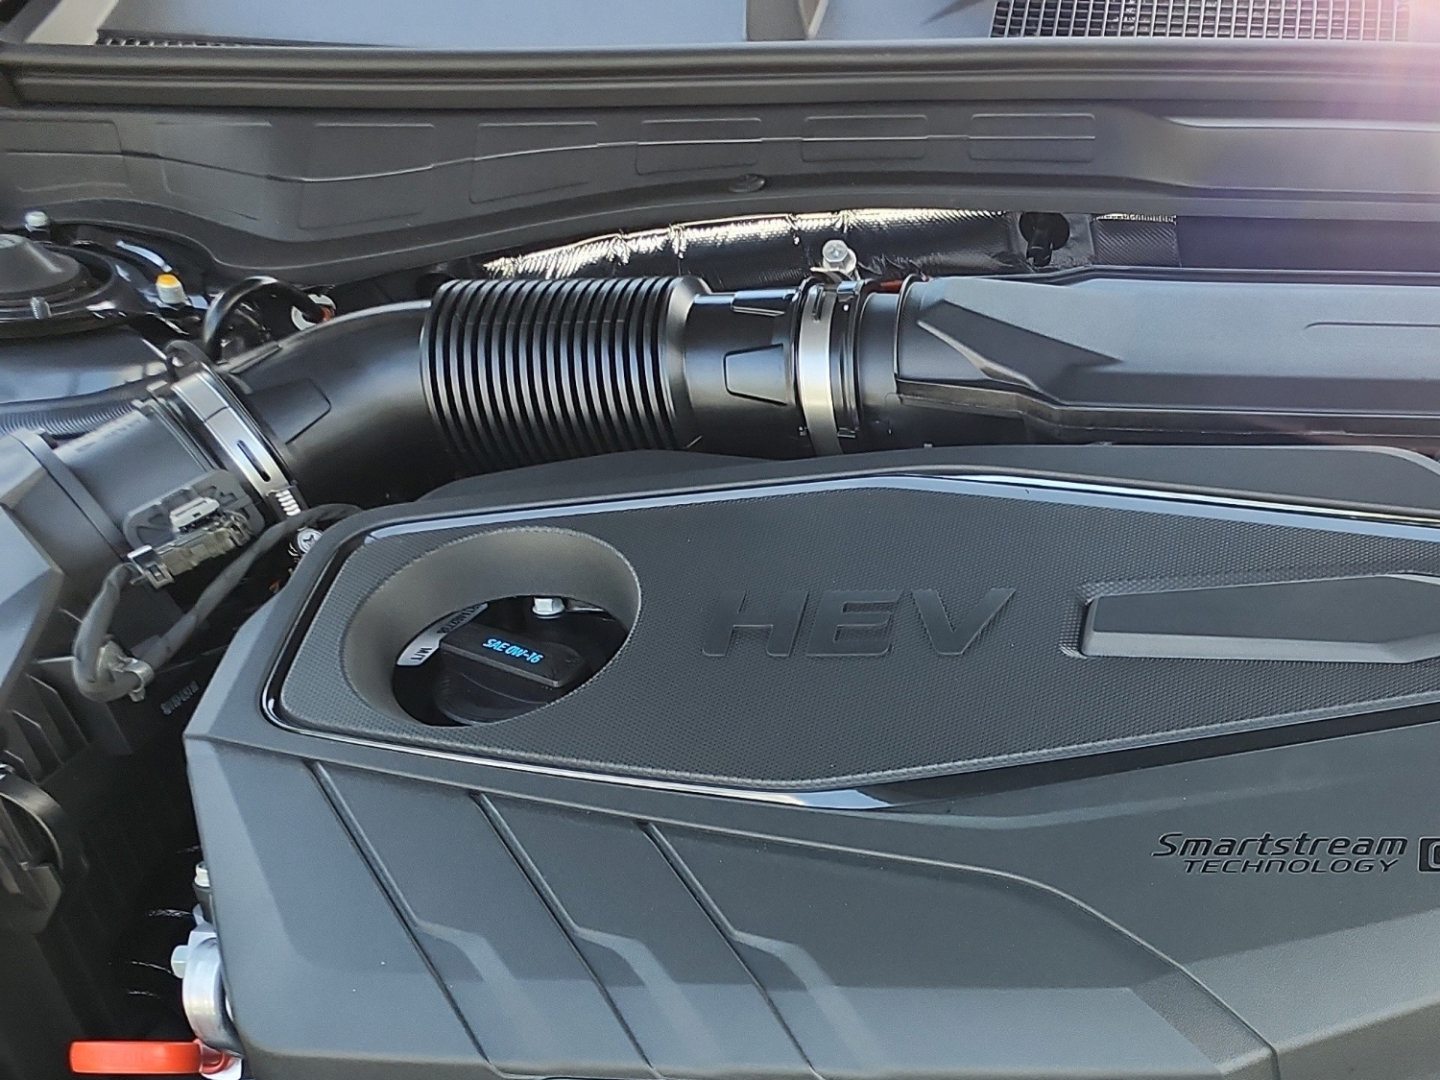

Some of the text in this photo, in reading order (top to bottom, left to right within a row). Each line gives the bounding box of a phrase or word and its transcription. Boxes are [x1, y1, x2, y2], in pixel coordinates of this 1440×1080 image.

[700, 587, 1017, 658] HEV
[482, 638, 544, 665] SAE 0W-16
[1151, 831, 1409, 858] Smartstream
[1183, 858, 1400, 875] TECHNOLOGY
